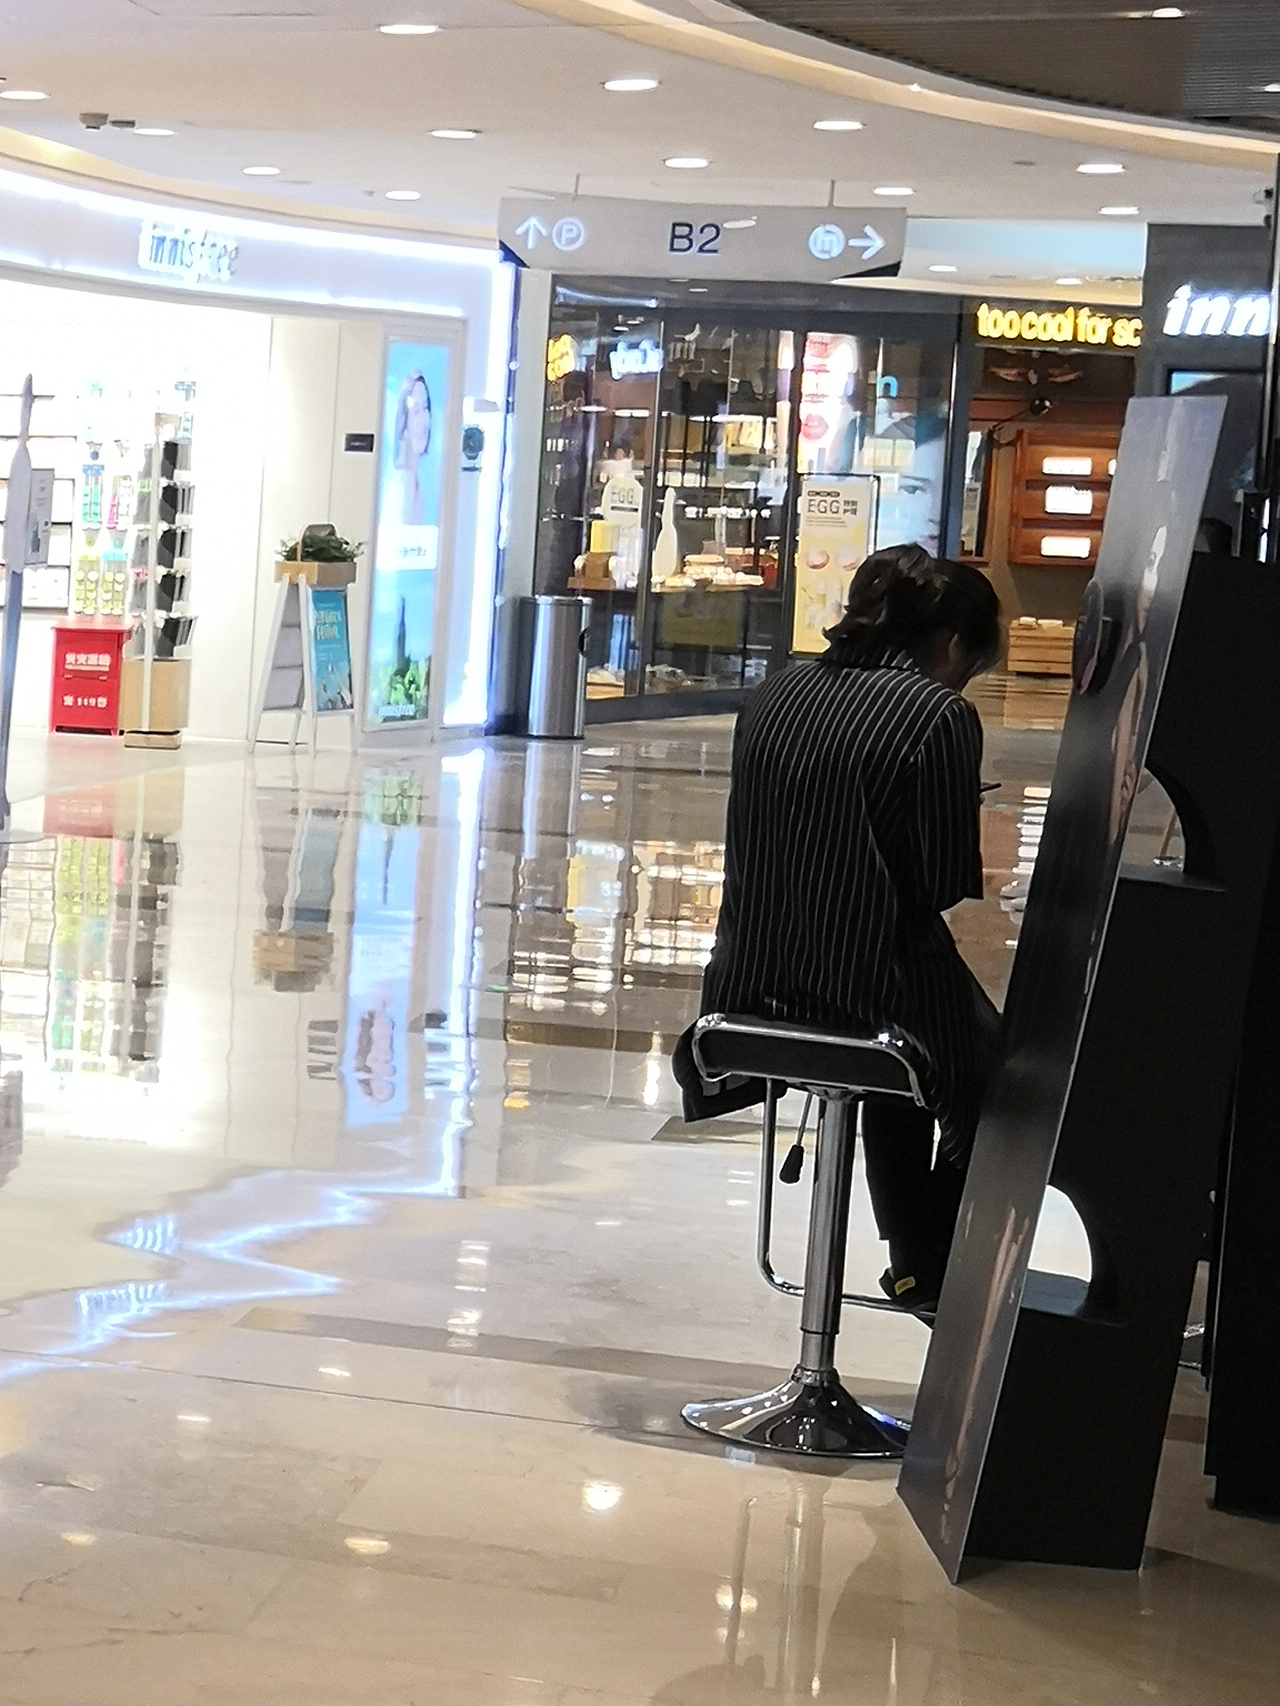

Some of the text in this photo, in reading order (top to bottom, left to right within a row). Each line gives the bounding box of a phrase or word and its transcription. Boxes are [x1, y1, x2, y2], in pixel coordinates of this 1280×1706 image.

[668, 221, 722, 255] B2
[1077, 307, 1112, 344] for
[807, 498, 840, 514] EGG
